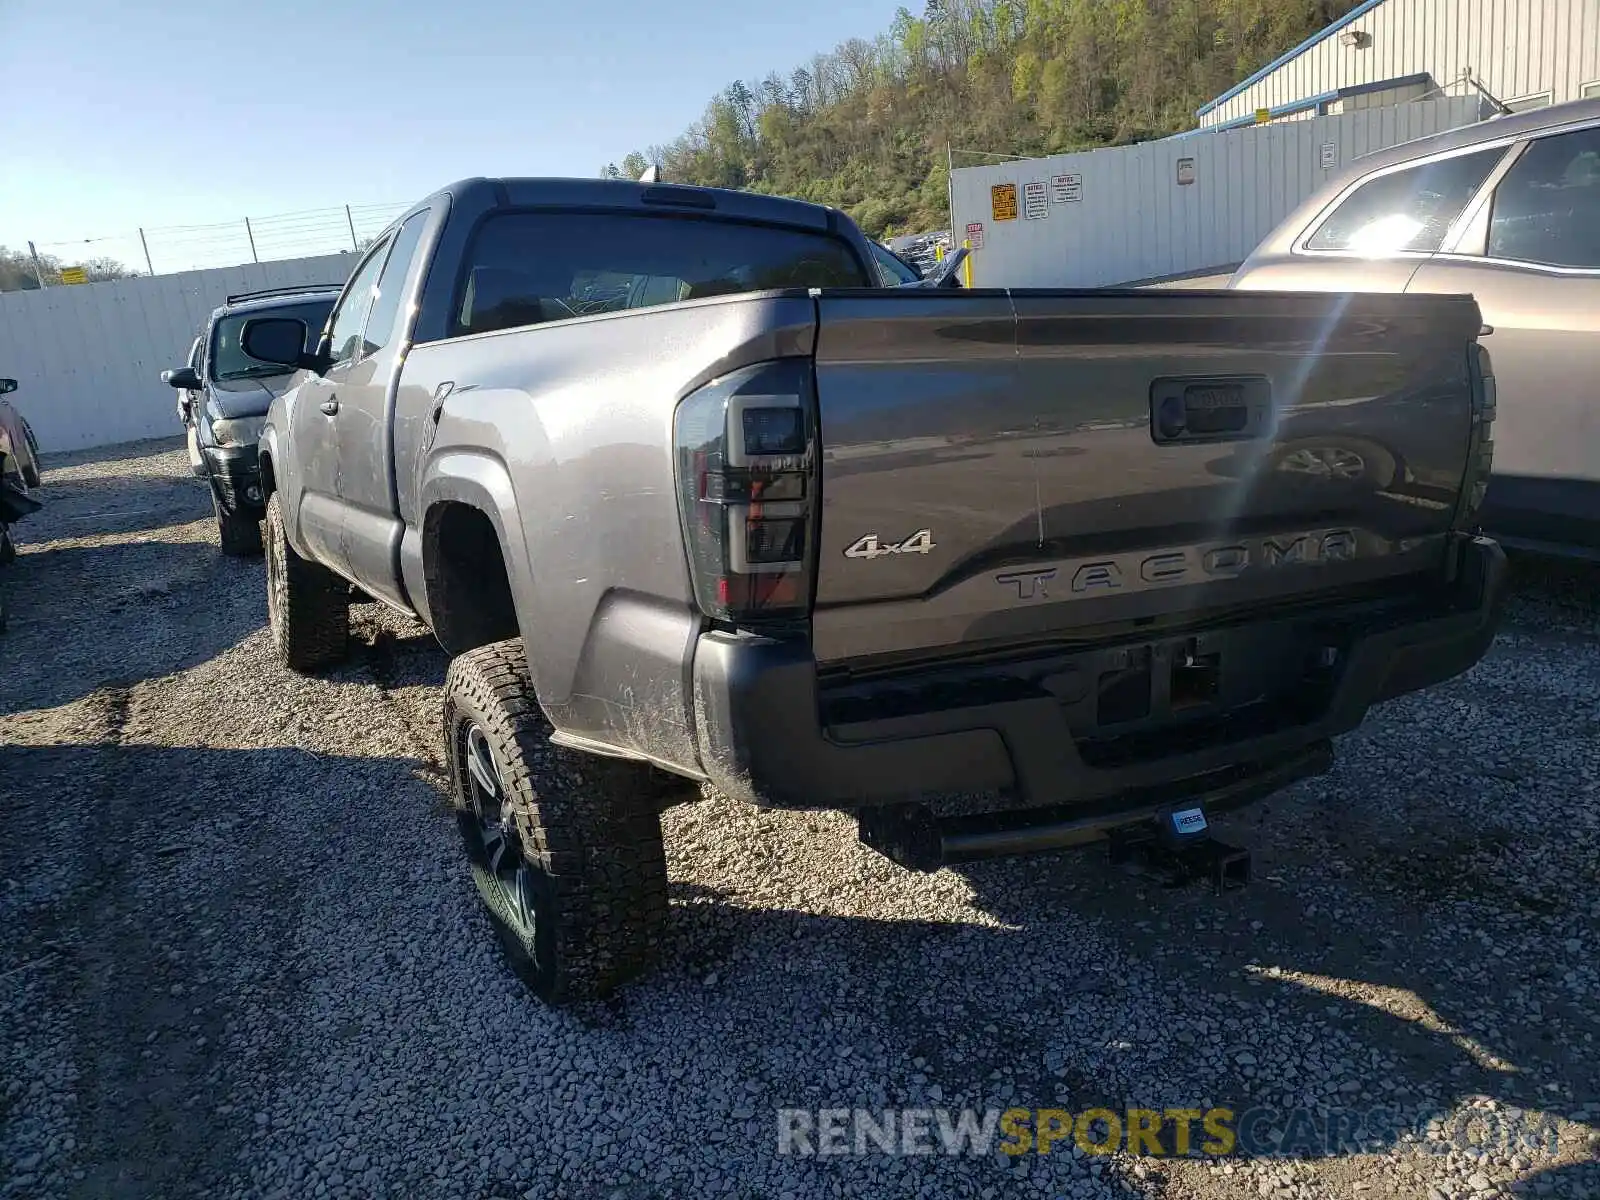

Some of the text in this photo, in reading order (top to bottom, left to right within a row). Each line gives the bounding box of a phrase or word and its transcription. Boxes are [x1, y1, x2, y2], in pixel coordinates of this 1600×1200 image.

[843, 528, 935, 560] 4x4
[996, 529, 1357, 599] TACOMA
[1179, 814, 1202, 825] REESE
